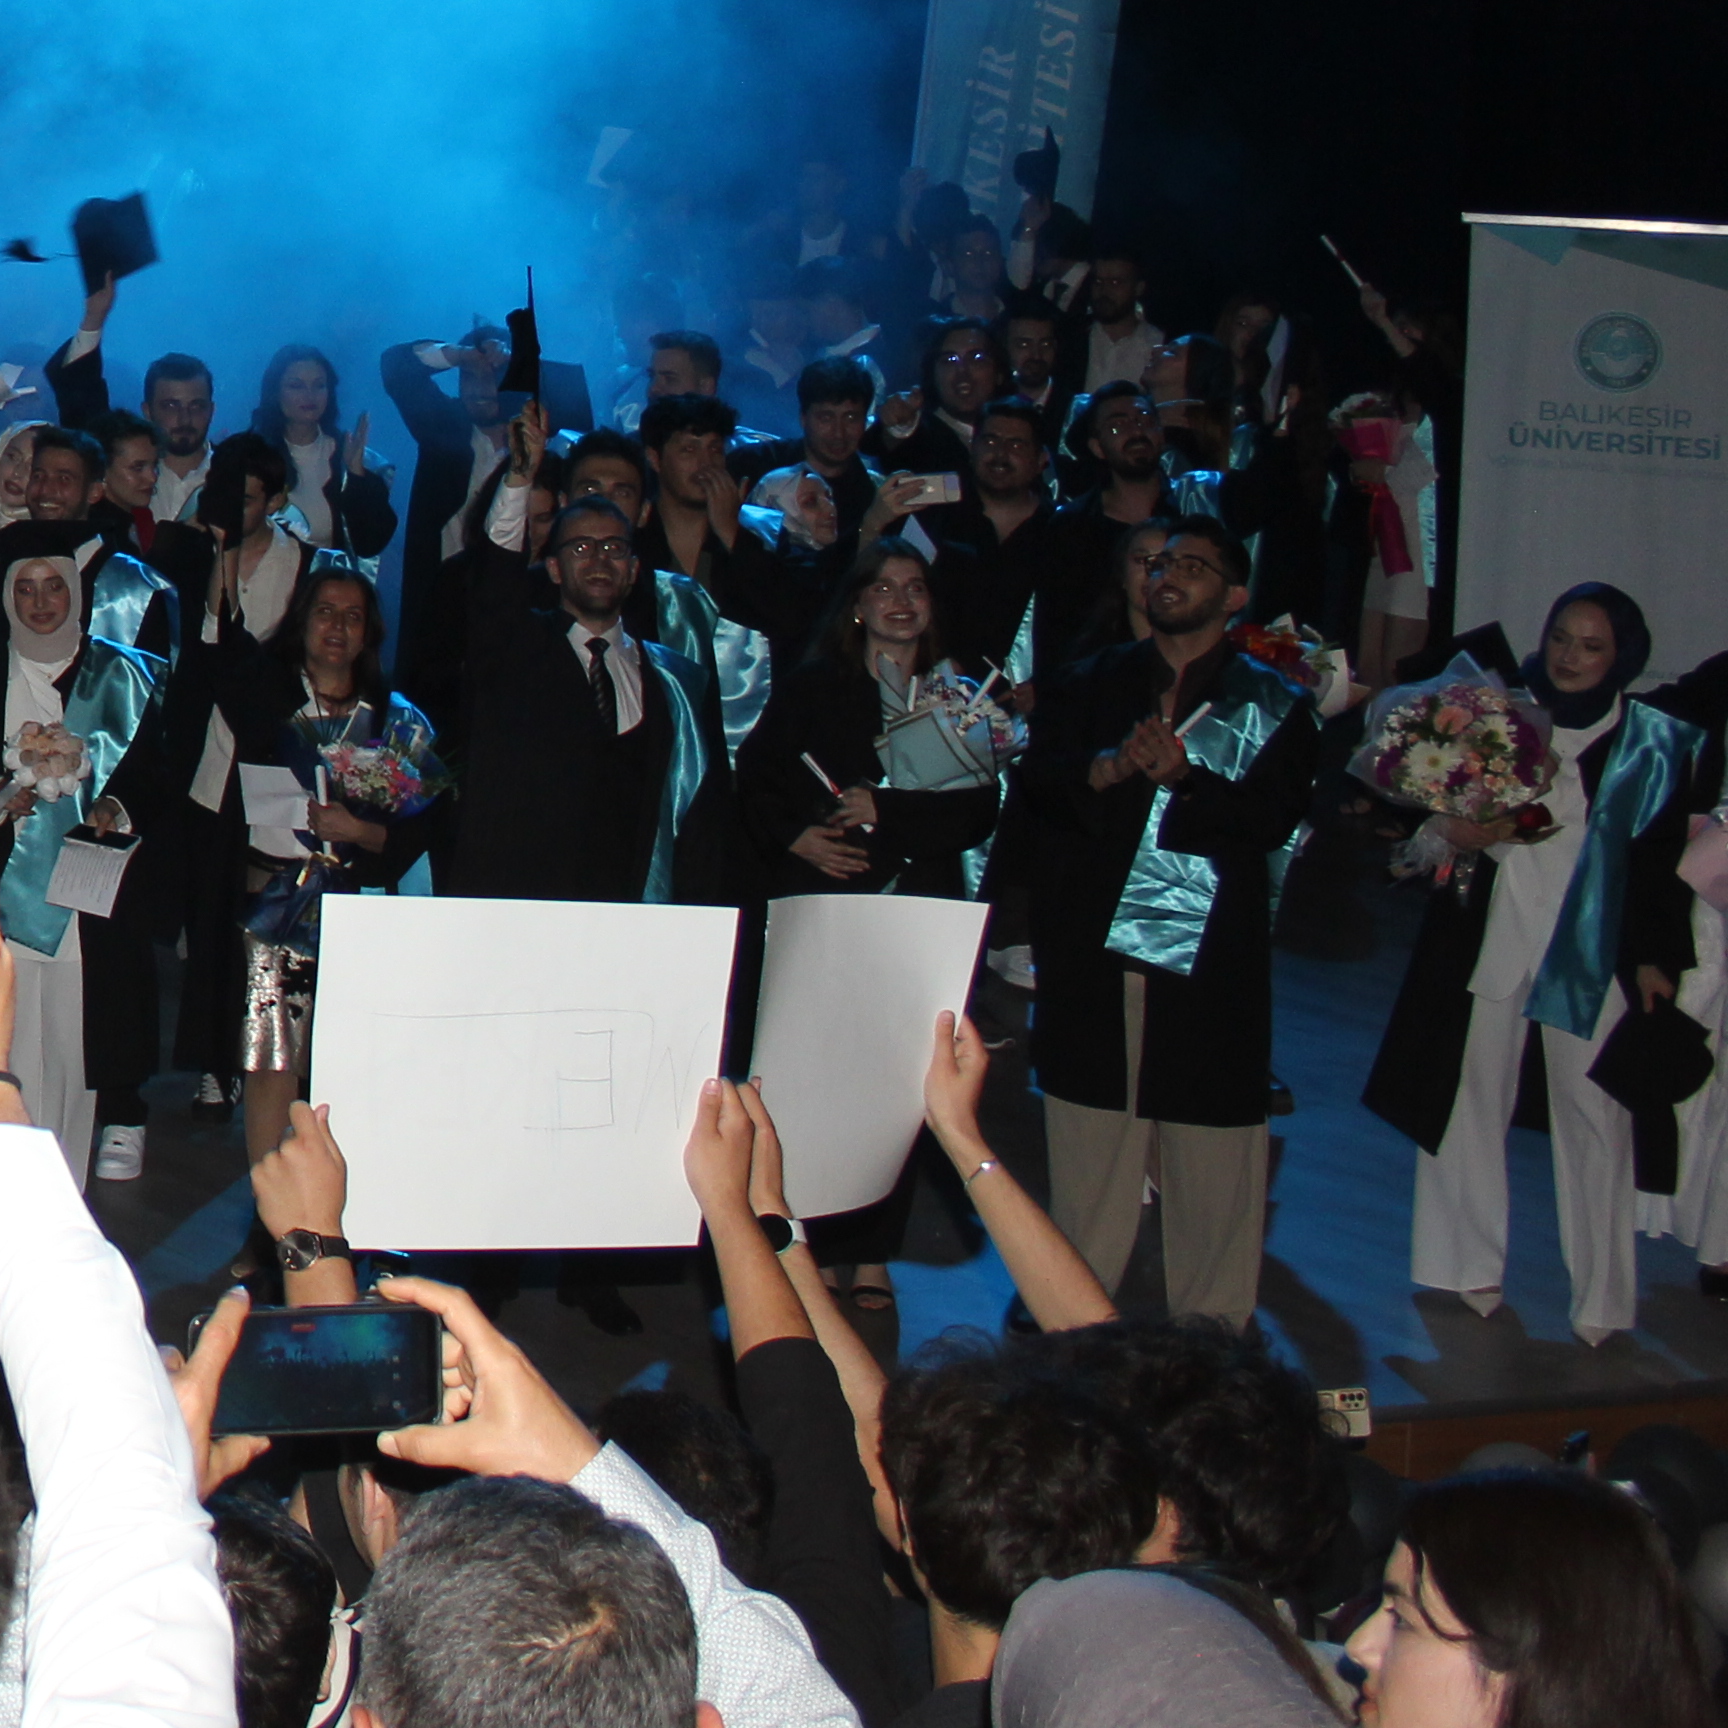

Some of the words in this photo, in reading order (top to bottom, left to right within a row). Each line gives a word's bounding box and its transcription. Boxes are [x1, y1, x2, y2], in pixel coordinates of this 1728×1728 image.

[961, 44, 1017, 224] KESİR
[1538, 400, 1693, 430] BALIKESİR
[1507, 421, 1722, 462] ÜNİVERSİTESİ
